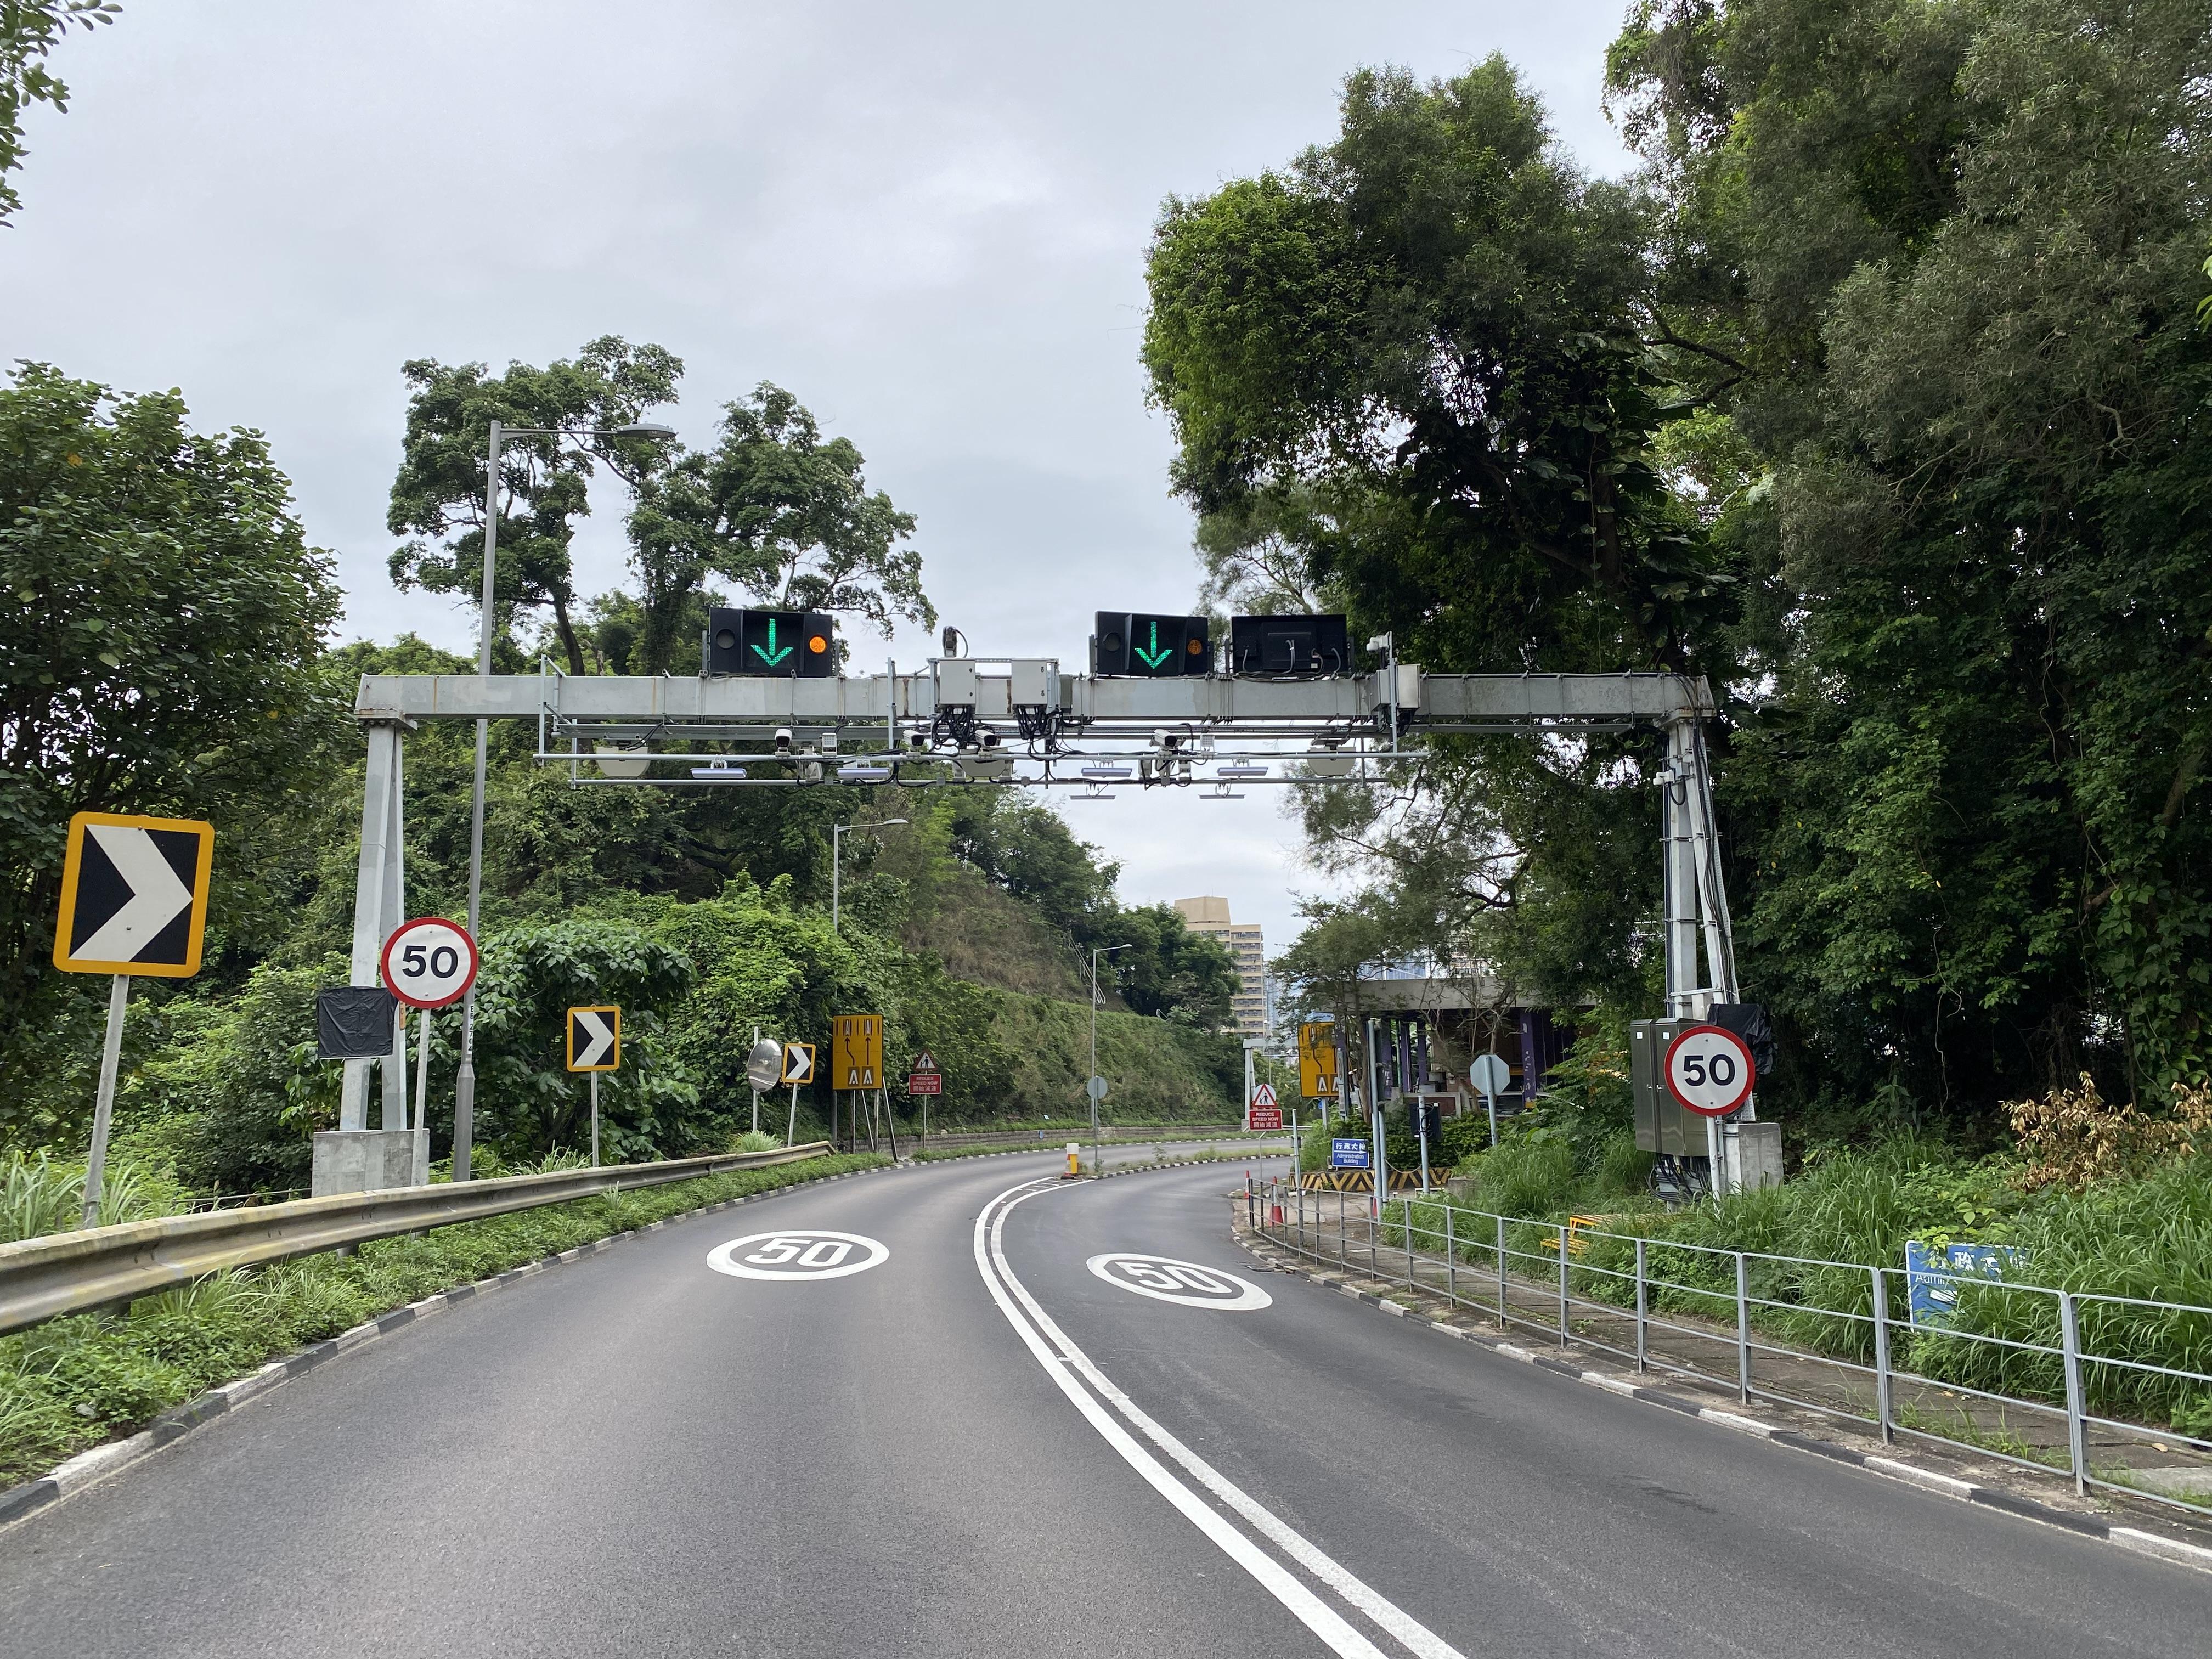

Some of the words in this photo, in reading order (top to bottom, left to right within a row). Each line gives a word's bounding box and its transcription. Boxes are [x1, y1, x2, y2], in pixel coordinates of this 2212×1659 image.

[402, 945, 458, 978] 50
[1683, 1054, 1735, 1086] 50
[744, 1238, 853, 1267] 50
[1114, 1261, 1233, 1294] 50
